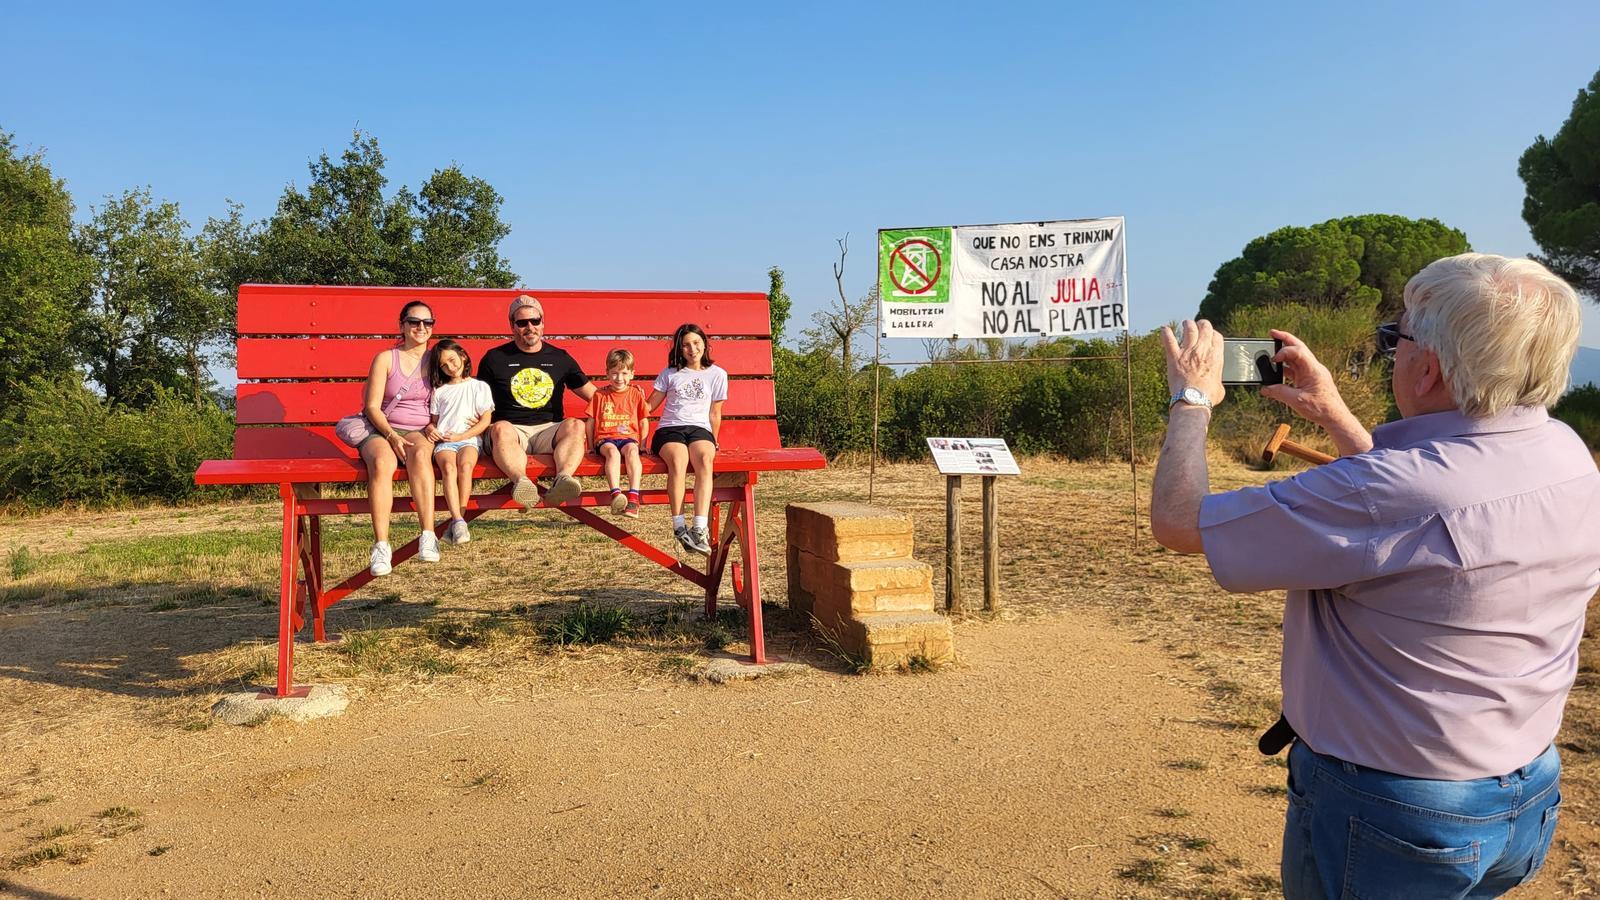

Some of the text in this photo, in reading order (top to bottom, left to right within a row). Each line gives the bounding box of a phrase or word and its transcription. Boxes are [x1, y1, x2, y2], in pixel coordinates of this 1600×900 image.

[972, 229, 1114, 250] QUE NO ENS TRINXIN
[991, 253, 1084, 271] CASA NOSTRA
[981, 277, 1101, 306] NO AL JULIA
[983, 303, 1125, 334] NO AL PLATER
